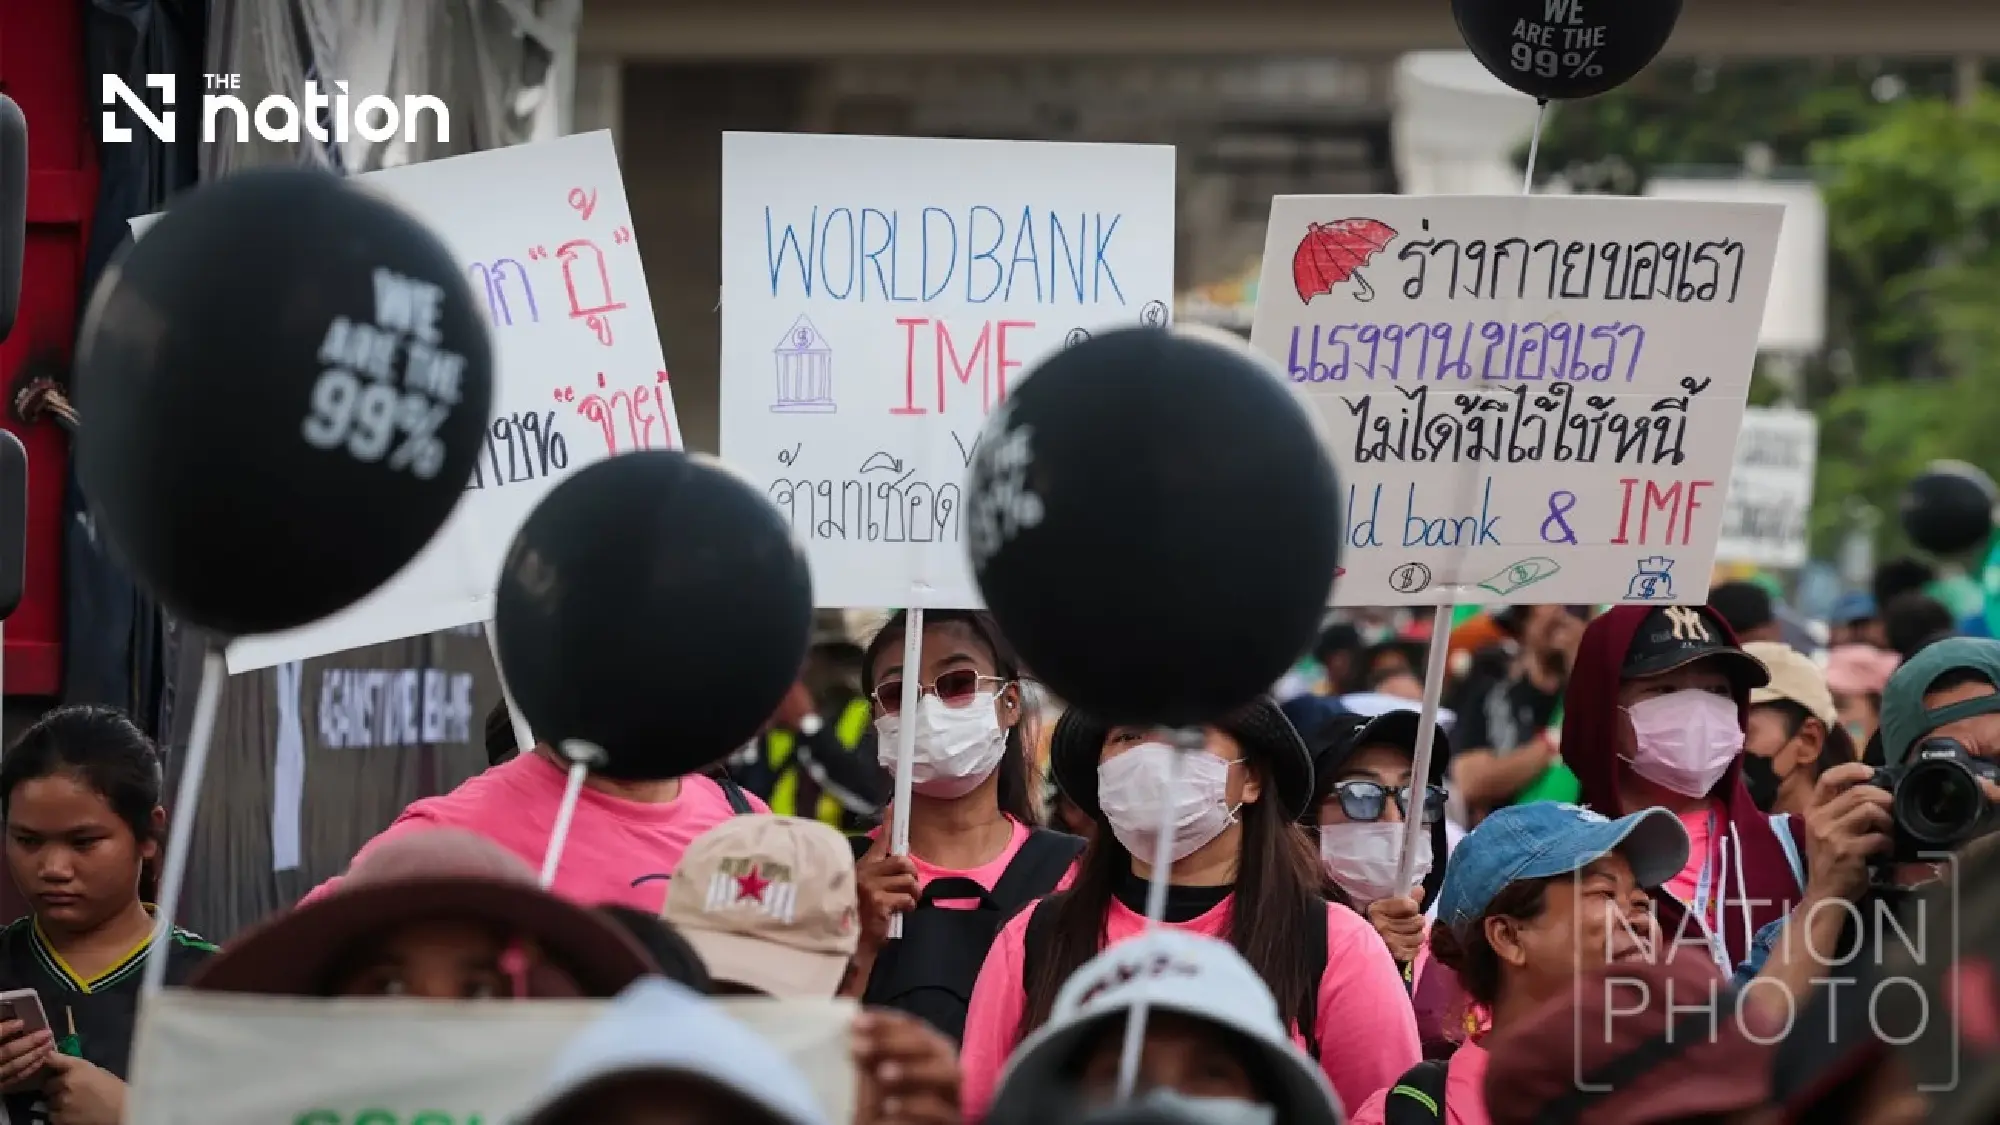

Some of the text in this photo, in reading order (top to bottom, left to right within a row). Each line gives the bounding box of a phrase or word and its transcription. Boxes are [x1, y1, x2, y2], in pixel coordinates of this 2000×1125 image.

[1512, 18, 1606, 49] ARE THE
[1545, 0, 1583, 25] WE
[1510, 42, 1603, 78] 99%
[1398, 219, 1745, 303] ร่างกายของเรา
[372, 266, 446, 346] WE
[317, 315, 398, 381] ARE
[889, 317, 1036, 415] IMF
[1288, 320, 1646, 383] แรงงานของเรา
[302, 369, 450, 480] 99%
[1340, 376, 1711, 465] ไม่ได้มีไว้ใช้หนี้
[1346, 482, 1383, 548] ld
[1403, 476, 1501, 548] bank
[1540, 491, 1578, 546] &
[1610, 478, 1714, 546] IMF
